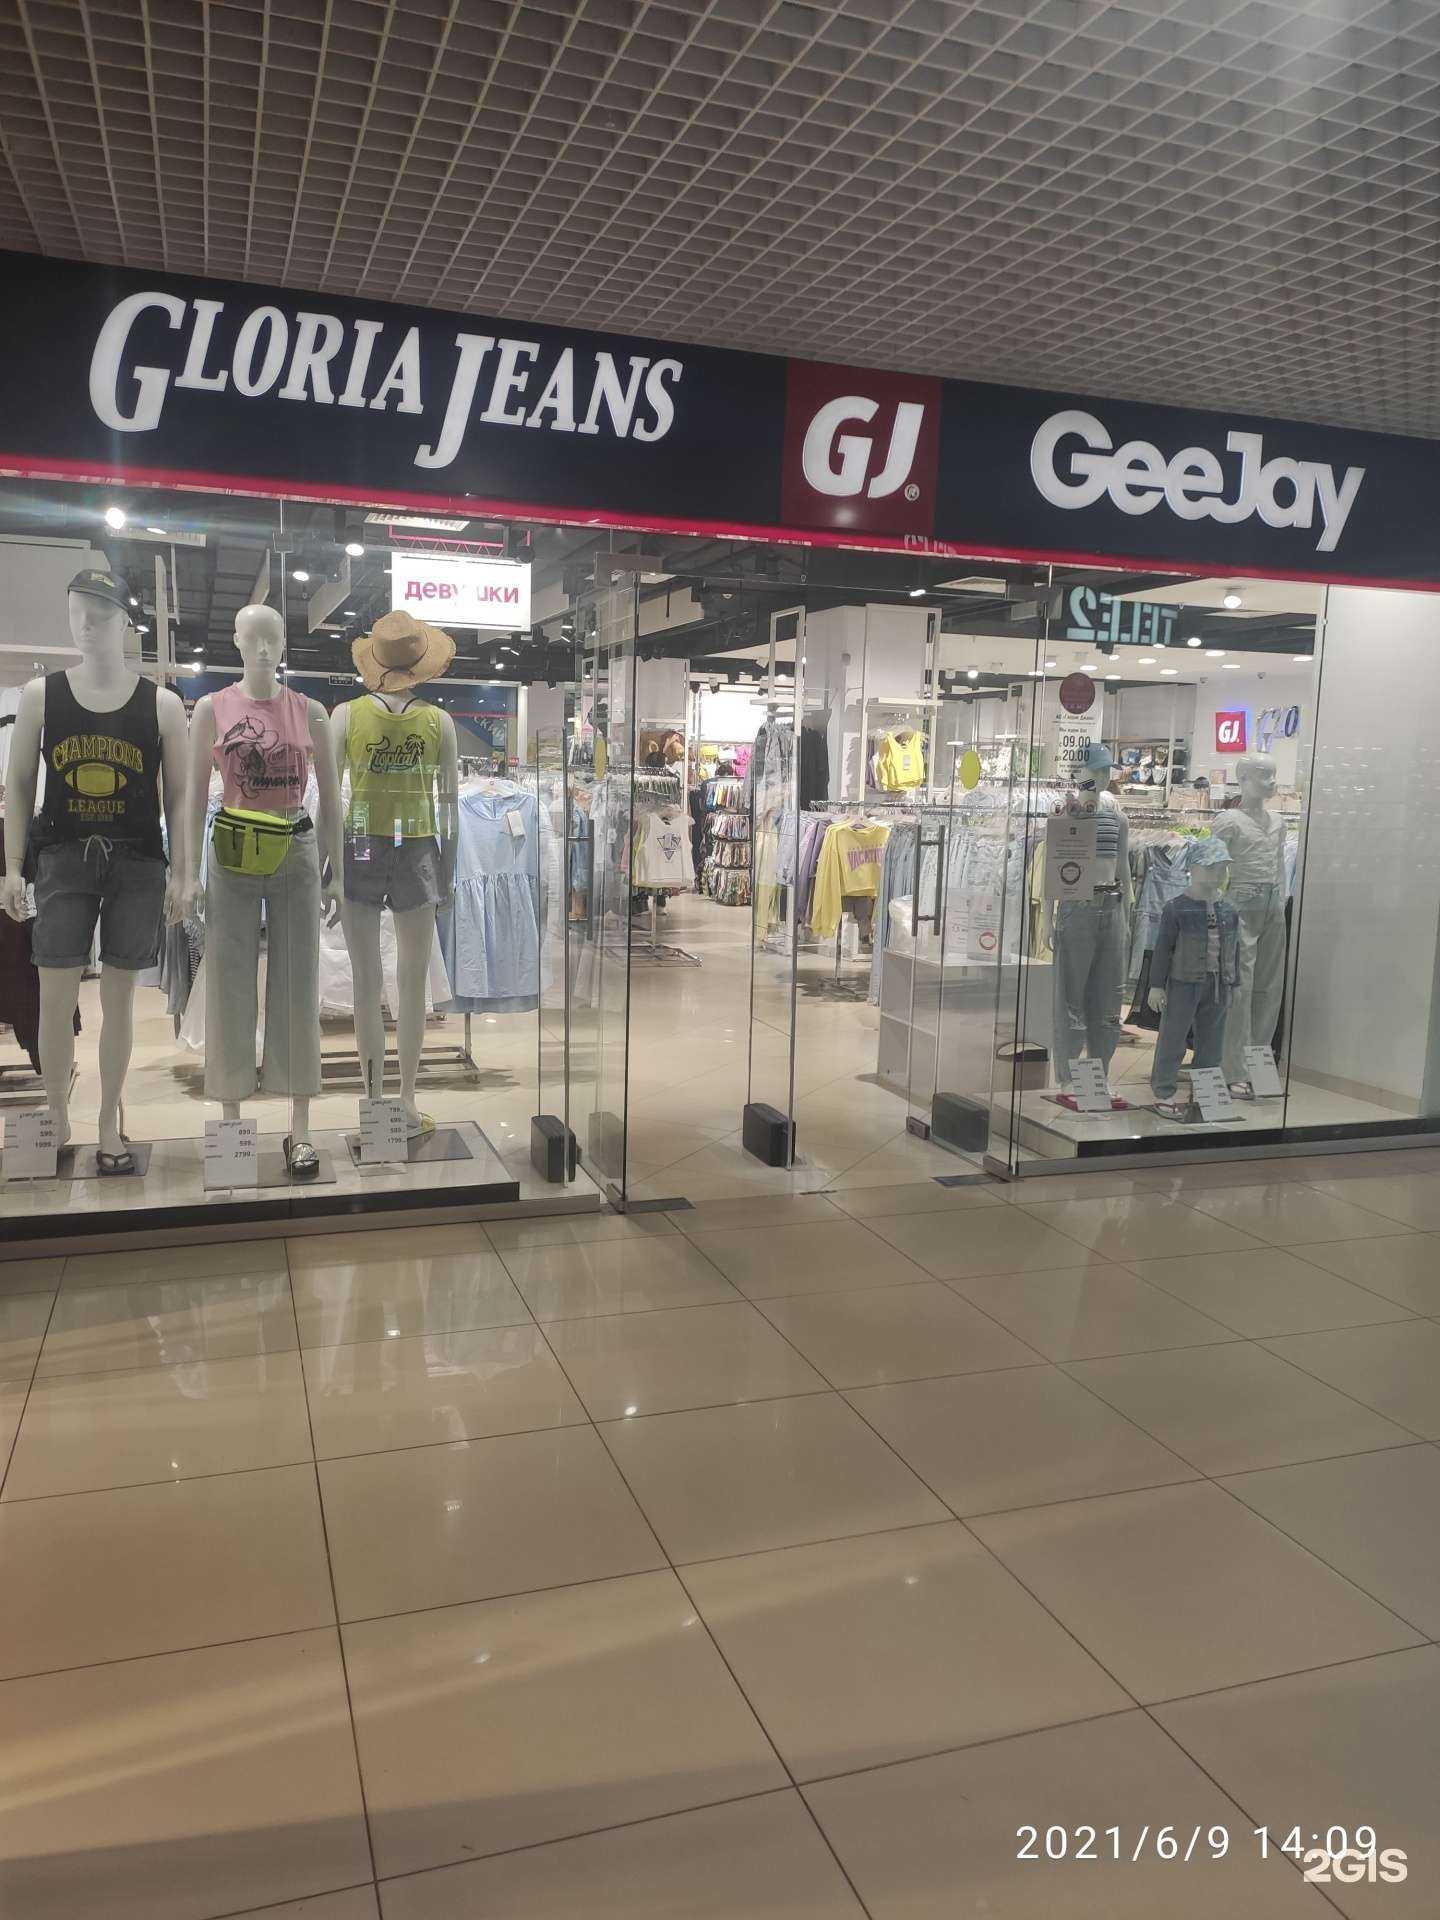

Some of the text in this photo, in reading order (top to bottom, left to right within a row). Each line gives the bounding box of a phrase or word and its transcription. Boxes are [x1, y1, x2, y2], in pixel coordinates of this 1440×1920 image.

[88, 291, 684, 469] GLORIA JEANS
[1030, 409, 1366, 552] GeeJay
[52, 735, 144, 774] CHAMPIONS
[1063, 735, 1091, 748] 09.00
[1063, 749, 1090, 762] 20.00
[68, 799, 126, 814] LEAGUE
